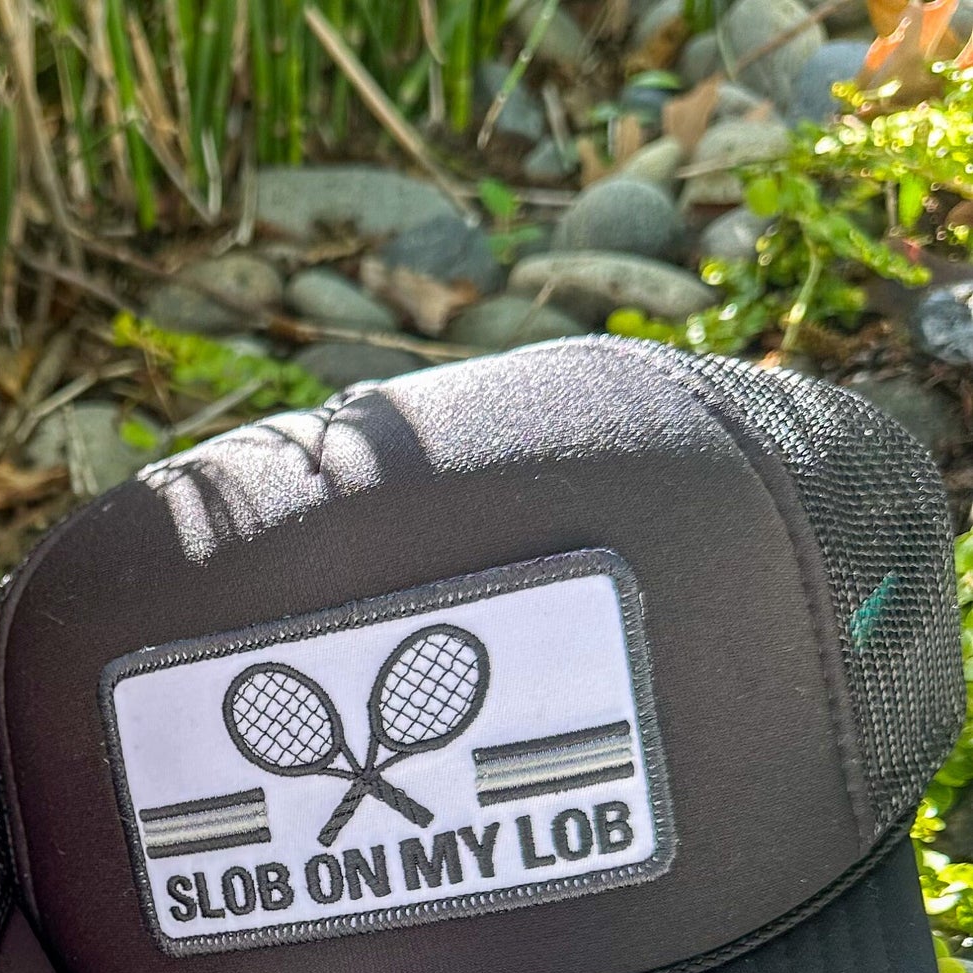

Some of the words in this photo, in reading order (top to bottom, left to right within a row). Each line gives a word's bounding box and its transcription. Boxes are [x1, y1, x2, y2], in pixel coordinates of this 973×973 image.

[166, 861, 295, 922] SLOB
[304, 844, 391, 906] ON
[399, 821, 500, 888] MY
[516, 800, 634, 870] LOB
